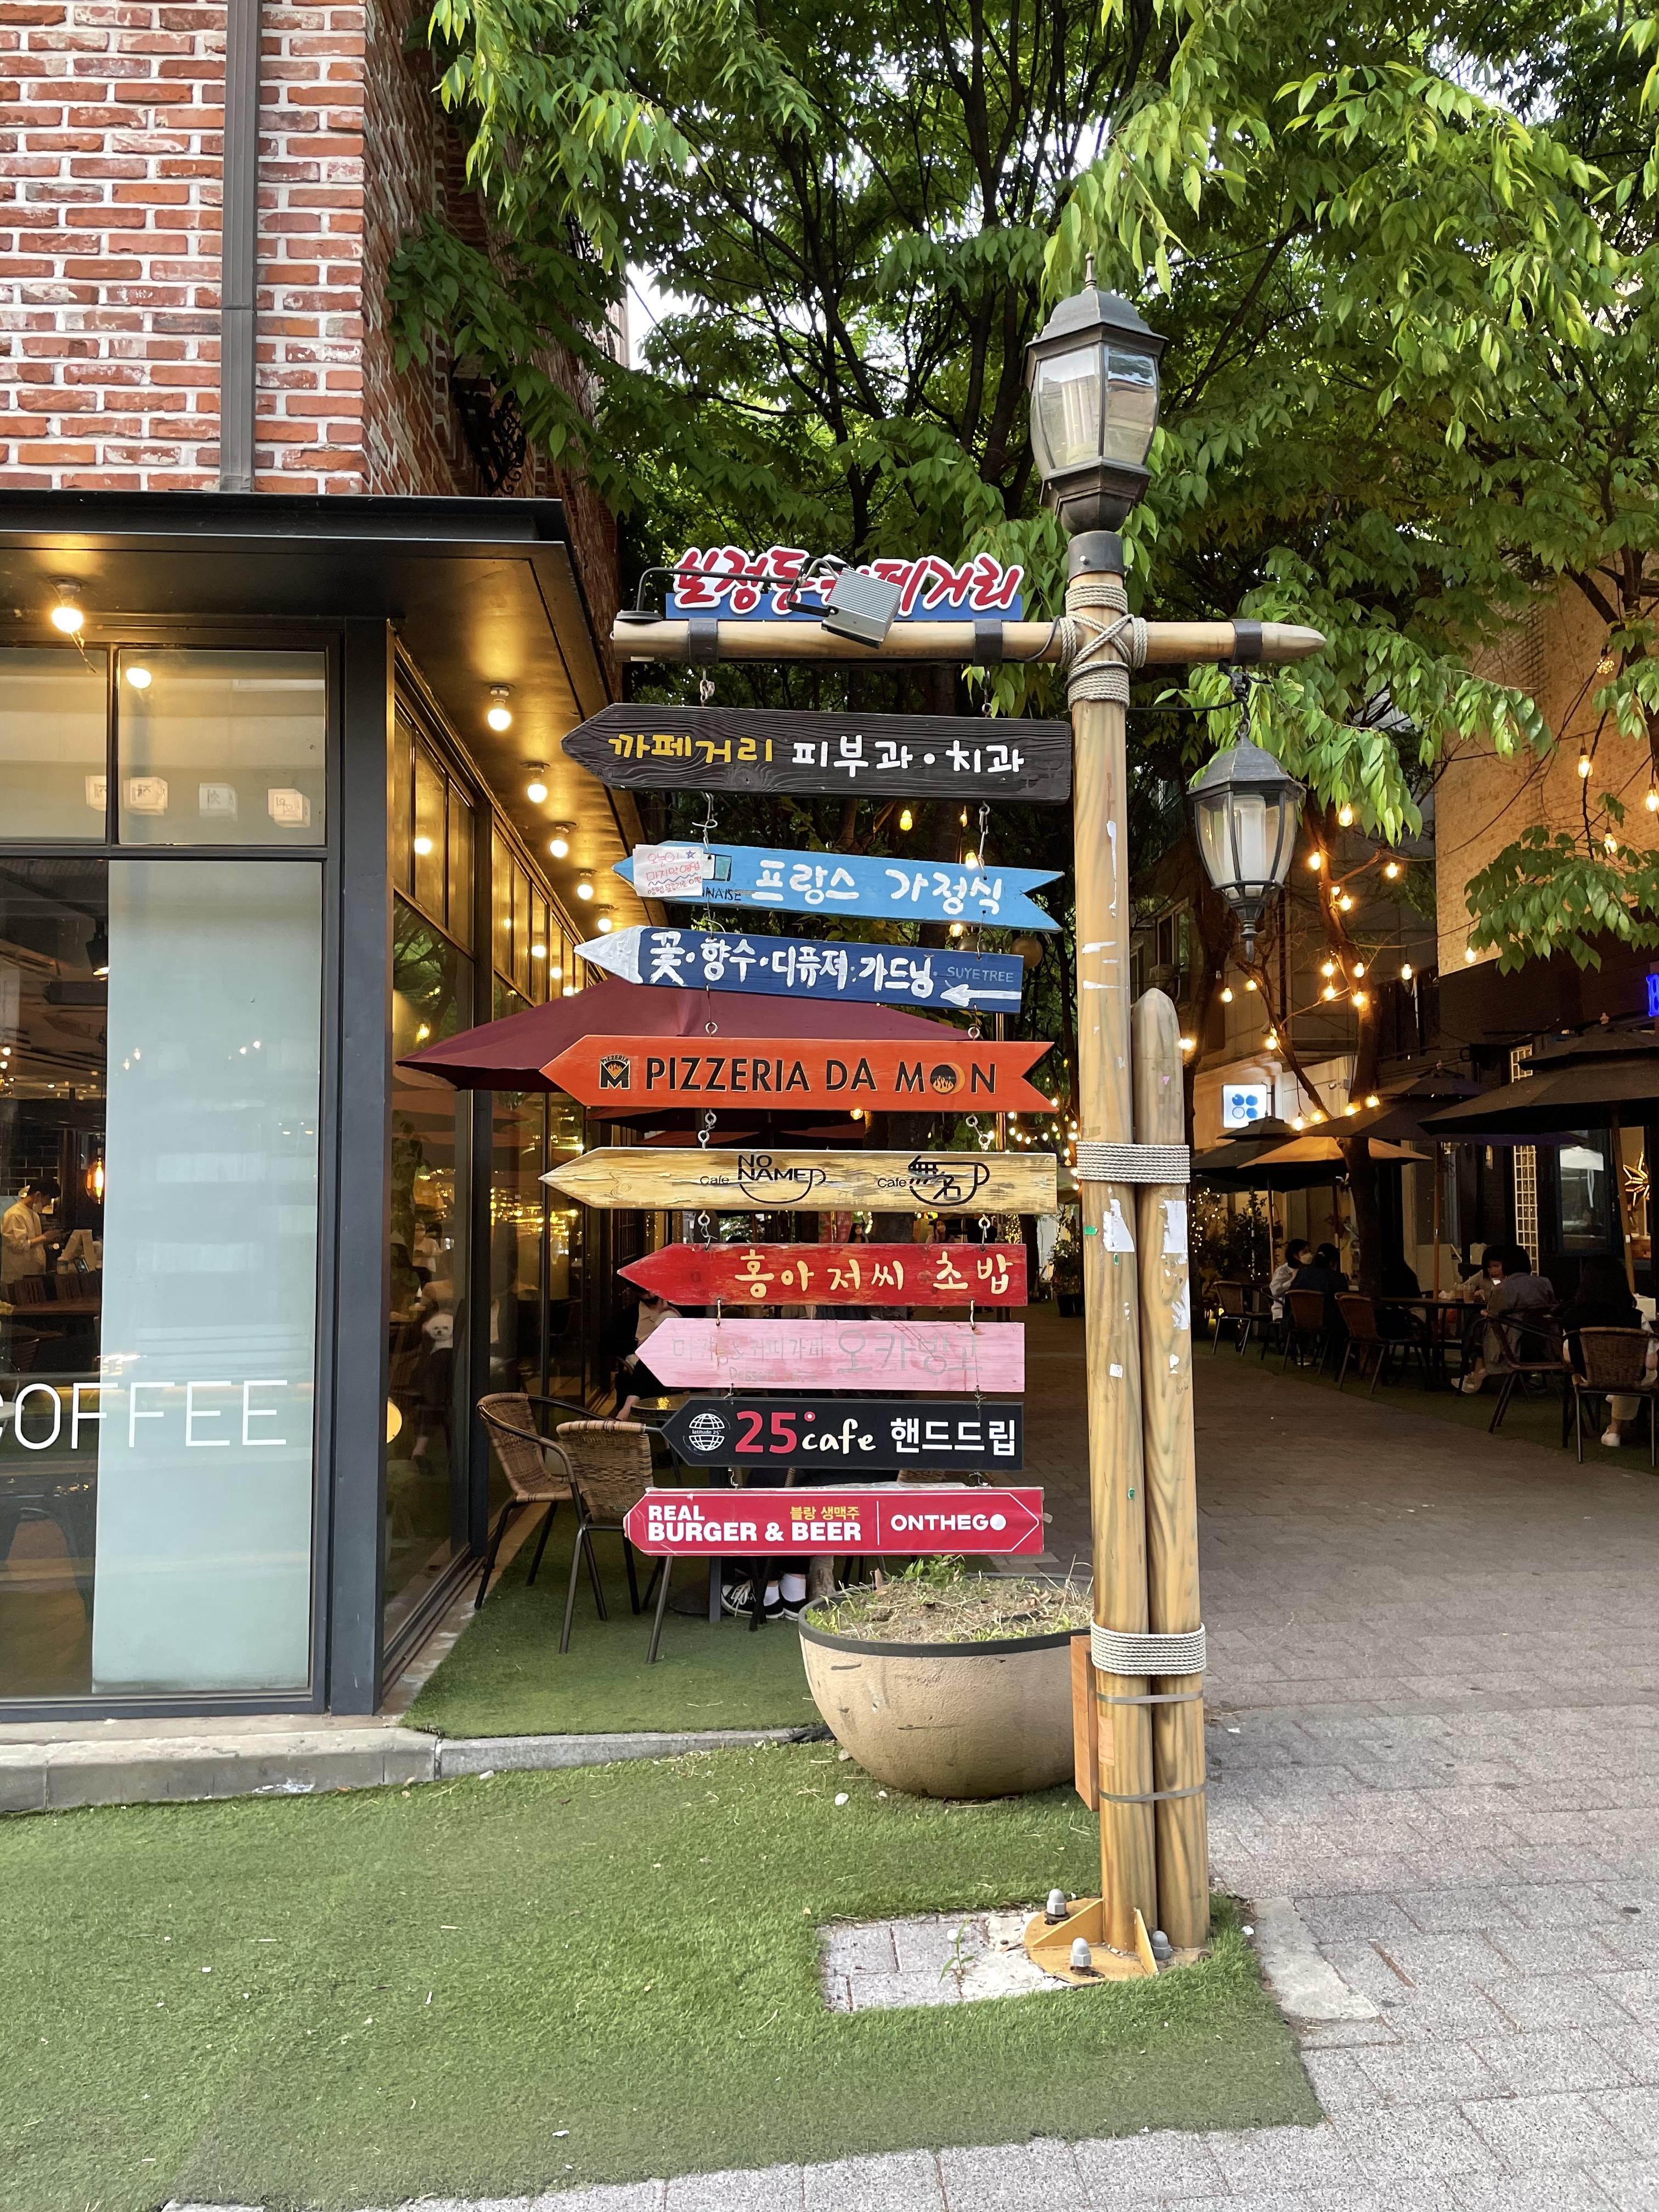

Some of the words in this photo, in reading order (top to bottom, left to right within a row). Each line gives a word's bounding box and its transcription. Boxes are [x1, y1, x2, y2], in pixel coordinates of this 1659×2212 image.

[646, 868, 678, 881] 마지막
[752, 860, 859, 905] 프랑스
[885, 868, 1001, 915] 가정식
[646, 1057, 810, 1093] PIZZERIA
[827, 1058, 877, 1092] DA
[738, 1154, 772, 1167] NO
[700, 1175, 730, 1186] Cafe
[878, 1177, 906, 1187] Cafe
[735, 1249, 904, 1298] 홍아저씨
[933, 1251, 1013, 1295] 초밥
[837, 1330, 983, 1375] 오카방고
[0, 1380, 287, 1450] OFFEE
[890, 1417, 1016, 1457] 핸드드립
[648, 1505, 705, 1522] REAL
[789, 1506, 816, 1520] 블랑
[821, 1506, 860, 1520] 생맥주
[648, 1522, 757, 1542] BURGER
[764, 1523, 785, 1542] &
[791, 1522, 861, 1542] BEER
